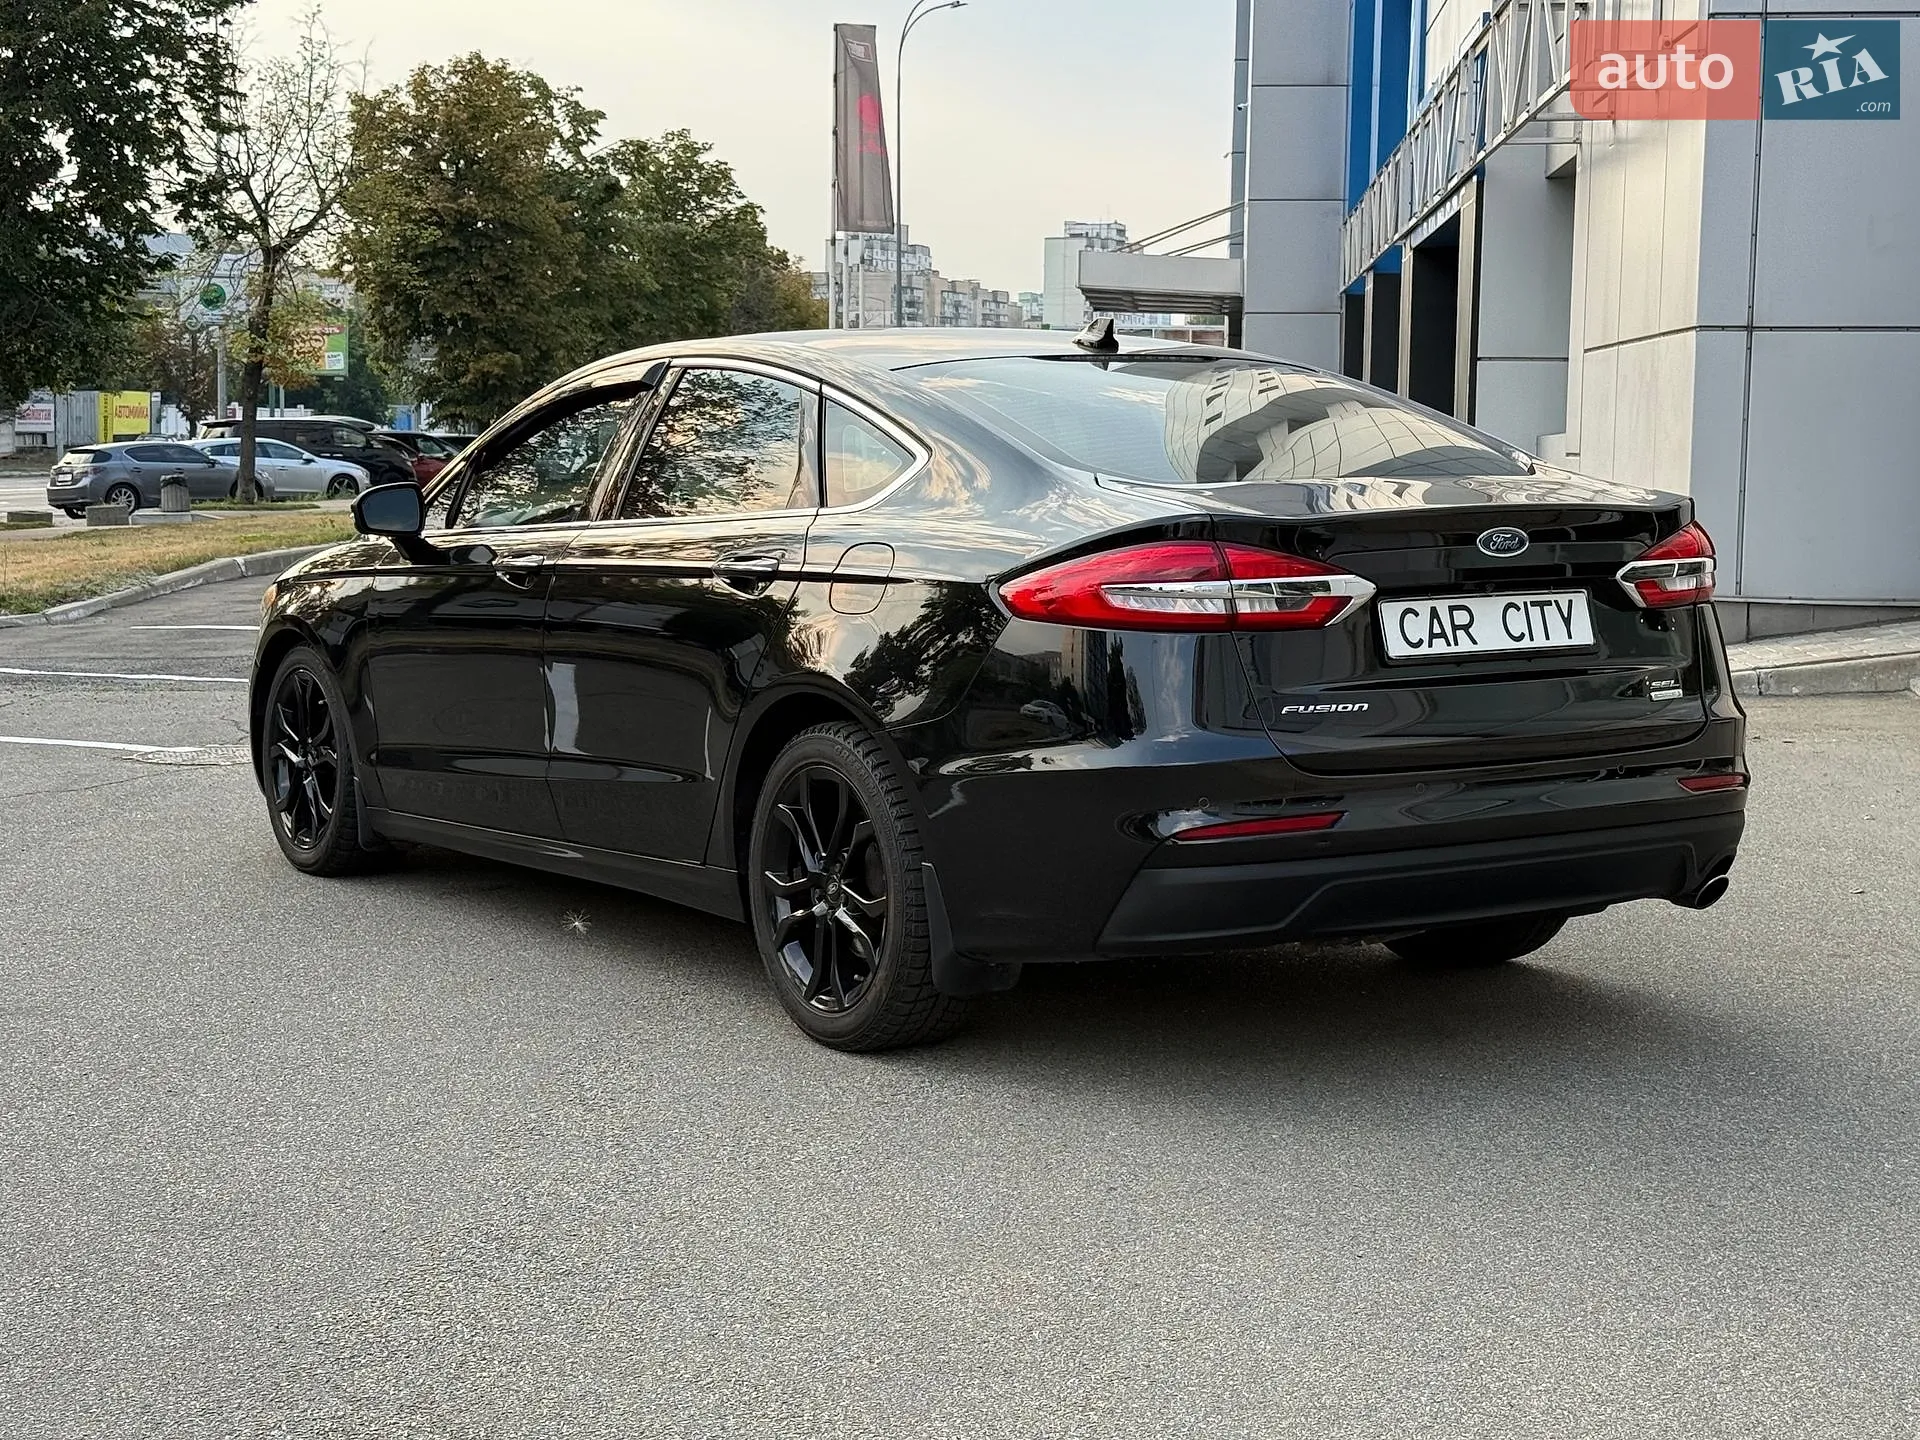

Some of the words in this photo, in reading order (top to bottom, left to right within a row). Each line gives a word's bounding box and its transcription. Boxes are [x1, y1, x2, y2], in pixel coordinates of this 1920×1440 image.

[1490, 533, 1519, 550] Ford
[1399, 605, 1478, 649] CAR
[1502, 599, 1573, 642] CITY
[1650, 680, 1681, 689] SEL
[1281, 703, 1369, 715] FUSION
